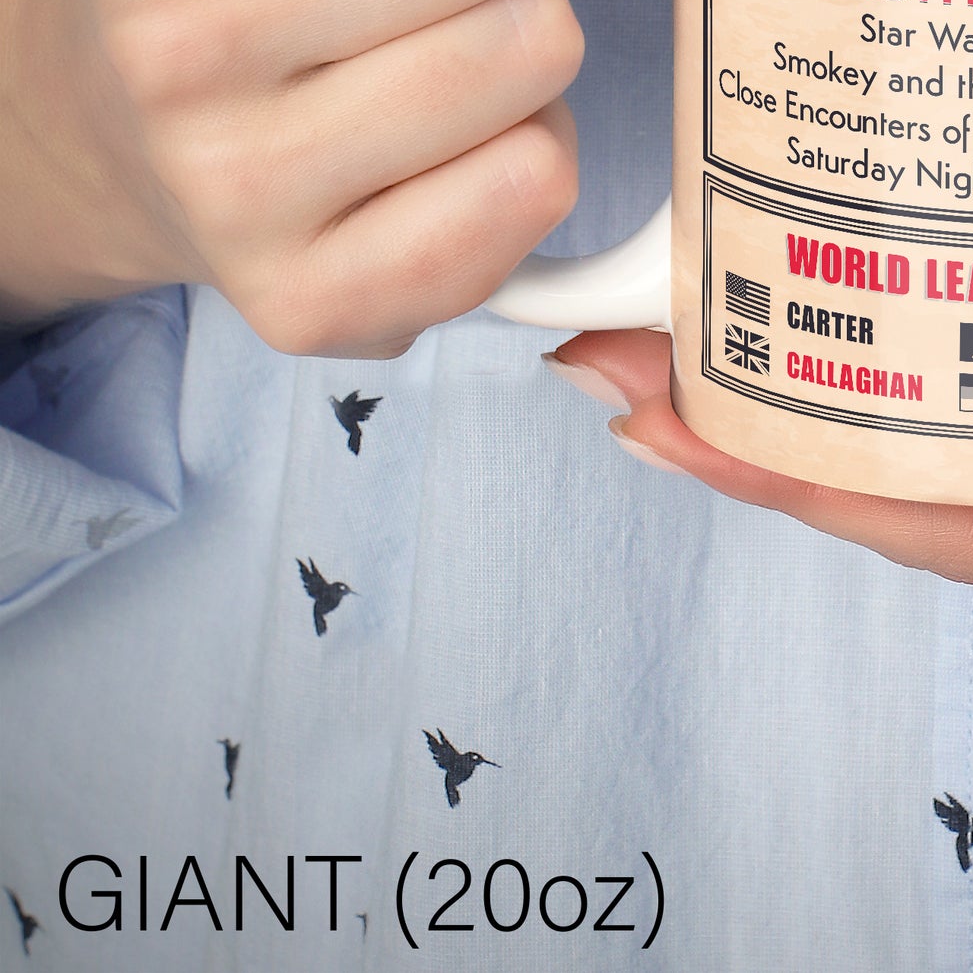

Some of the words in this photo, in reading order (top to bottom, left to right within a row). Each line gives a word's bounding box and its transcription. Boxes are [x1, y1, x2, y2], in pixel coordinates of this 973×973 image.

[859, 12, 917, 48] Star
[773, 41, 878, 96] Smokey
[888, 64, 945, 98] and
[718, 68, 778, 114] Close
[785, 91, 931, 142] Encounters
[942, 113, 971, 154] of
[786, 135, 906, 192] Saturday
[786, 233, 911, 296] WORLD
[786, 301, 874, 345] CARTER
[786, 351, 924, 402] CALLAGHAN
